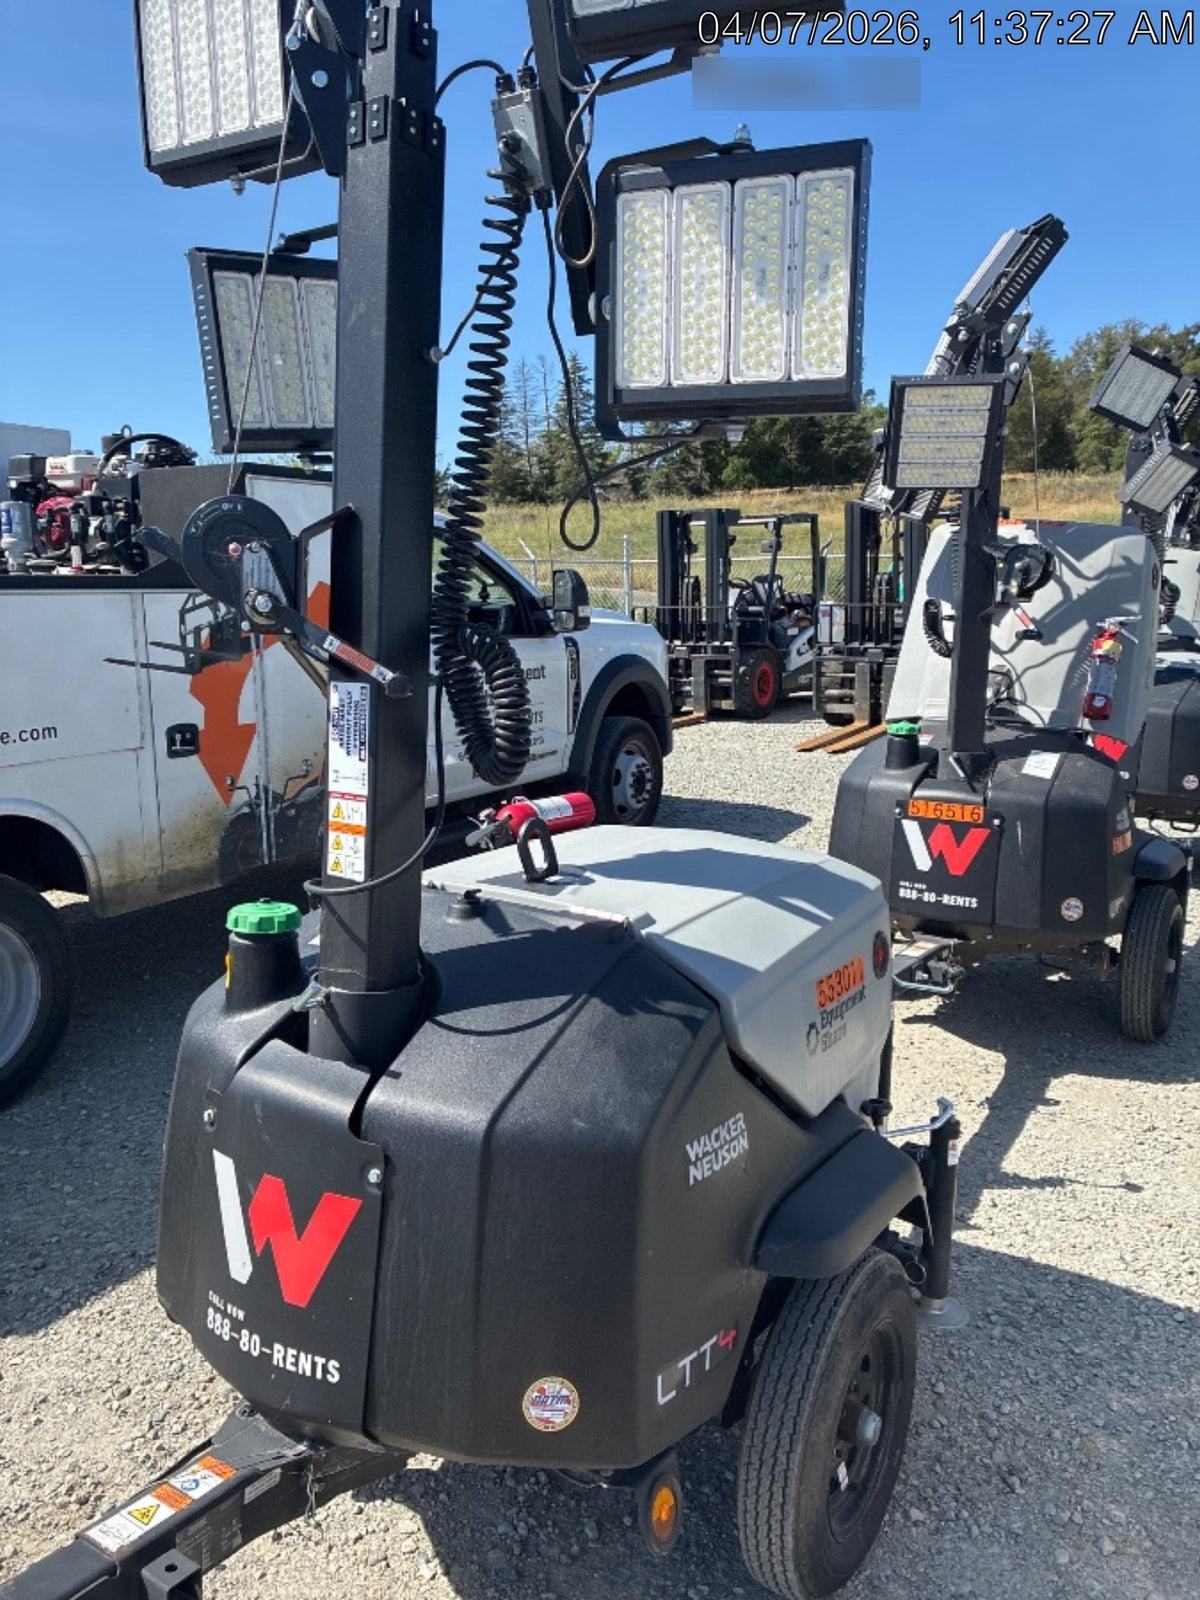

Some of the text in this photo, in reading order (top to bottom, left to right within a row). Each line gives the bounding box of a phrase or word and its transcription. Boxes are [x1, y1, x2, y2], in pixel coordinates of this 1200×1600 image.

[0, 726, 58, 745] e.com
[898, 887, 980, 909] 888-80-RENTS
[685, 1112, 747, 1163] WACKER
[688, 1130, 750, 1187] NEUSON
[226, 1304, 246, 1323] NOW
[206, 1306, 342, 1385] 888-80-RENTS
[656, 1327, 738, 1406] LTT4
